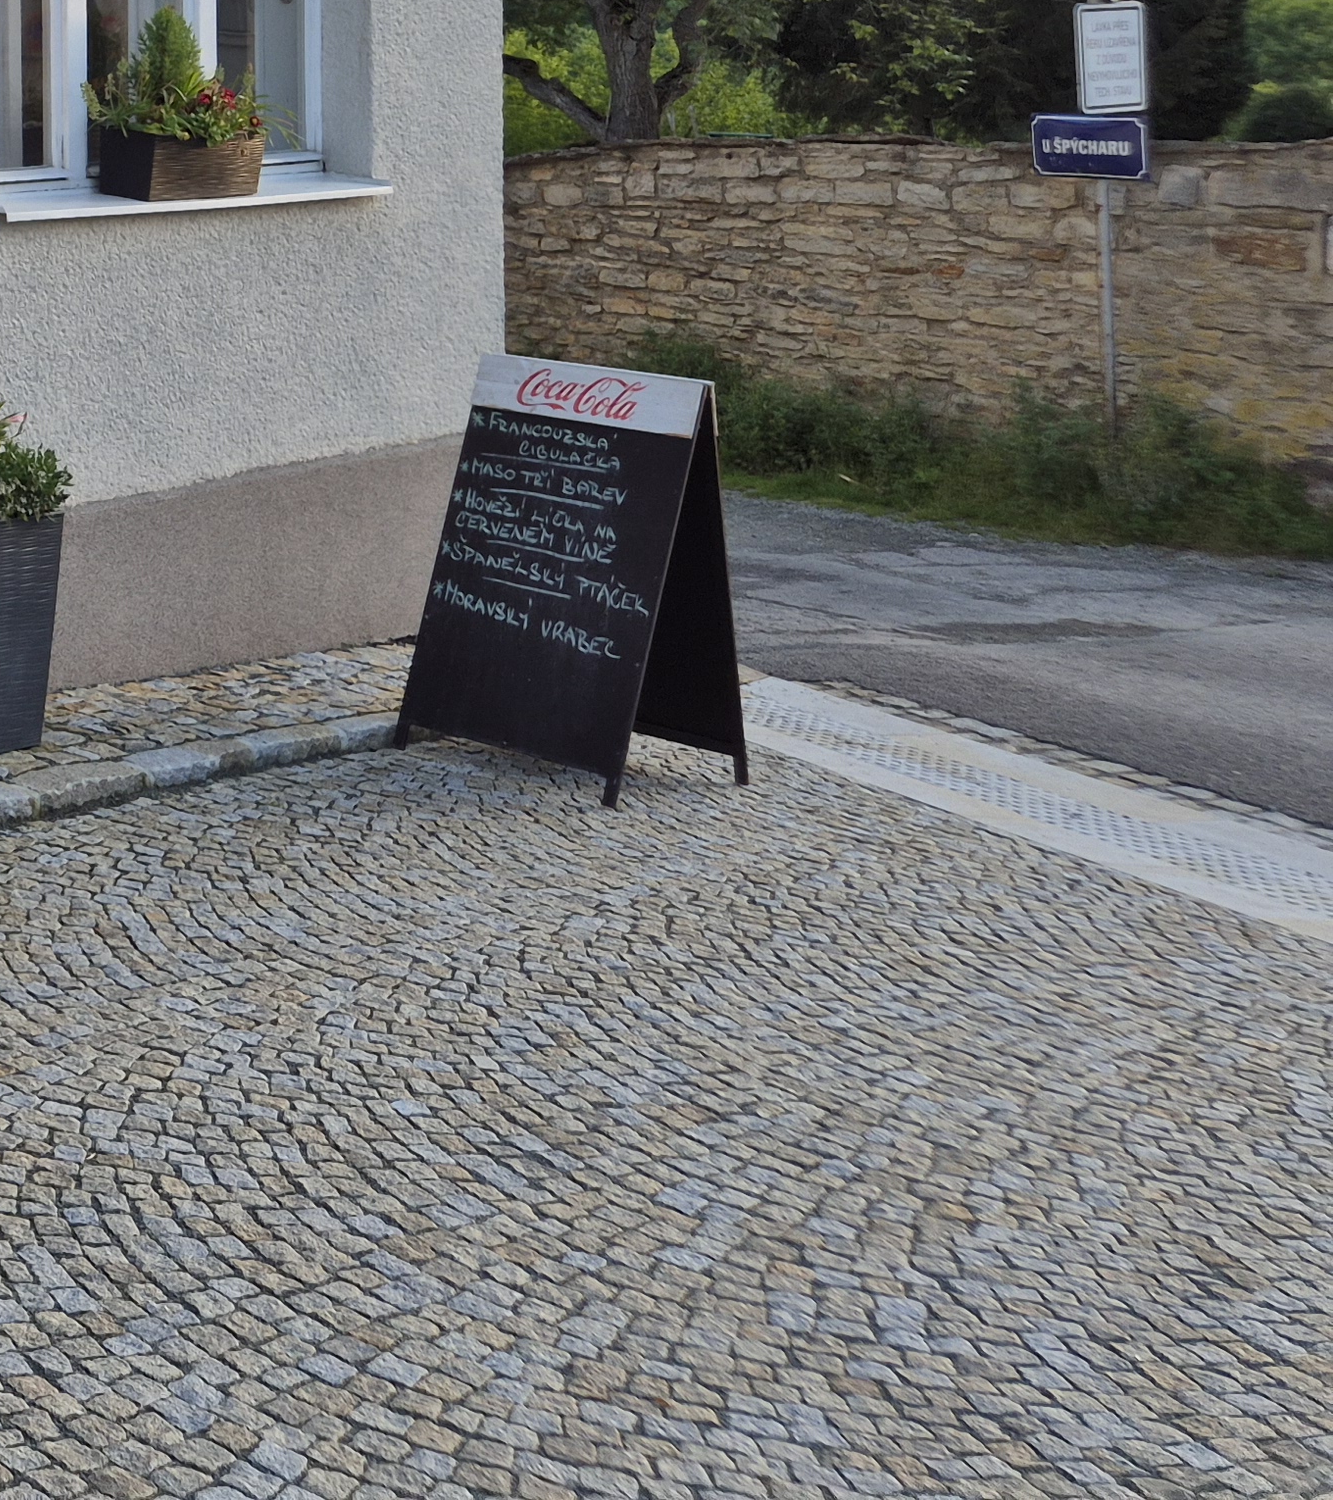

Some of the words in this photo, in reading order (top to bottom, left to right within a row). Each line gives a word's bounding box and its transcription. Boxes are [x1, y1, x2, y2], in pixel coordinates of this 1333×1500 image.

[1042, 138, 1050, 153] U
[1053, 136, 1132, 156] ŠPÝCHARU
[488, 411, 618, 450] FRANCOUZSKÁ
[519, 440, 621, 470] CIBULAČKA
[471, 457, 516, 481] MASO
[520, 468, 555, 489] TŘÍ
[561, 476, 628, 506] BAREV
[565, 536, 617, 564] VÍNĚ
[594, 523, 617, 543] NA
[574, 574, 650, 617] PTÁČEK
[445, 579, 534, 631] MORAVSKÝ
[541, 619, 622, 660] VRABEC
